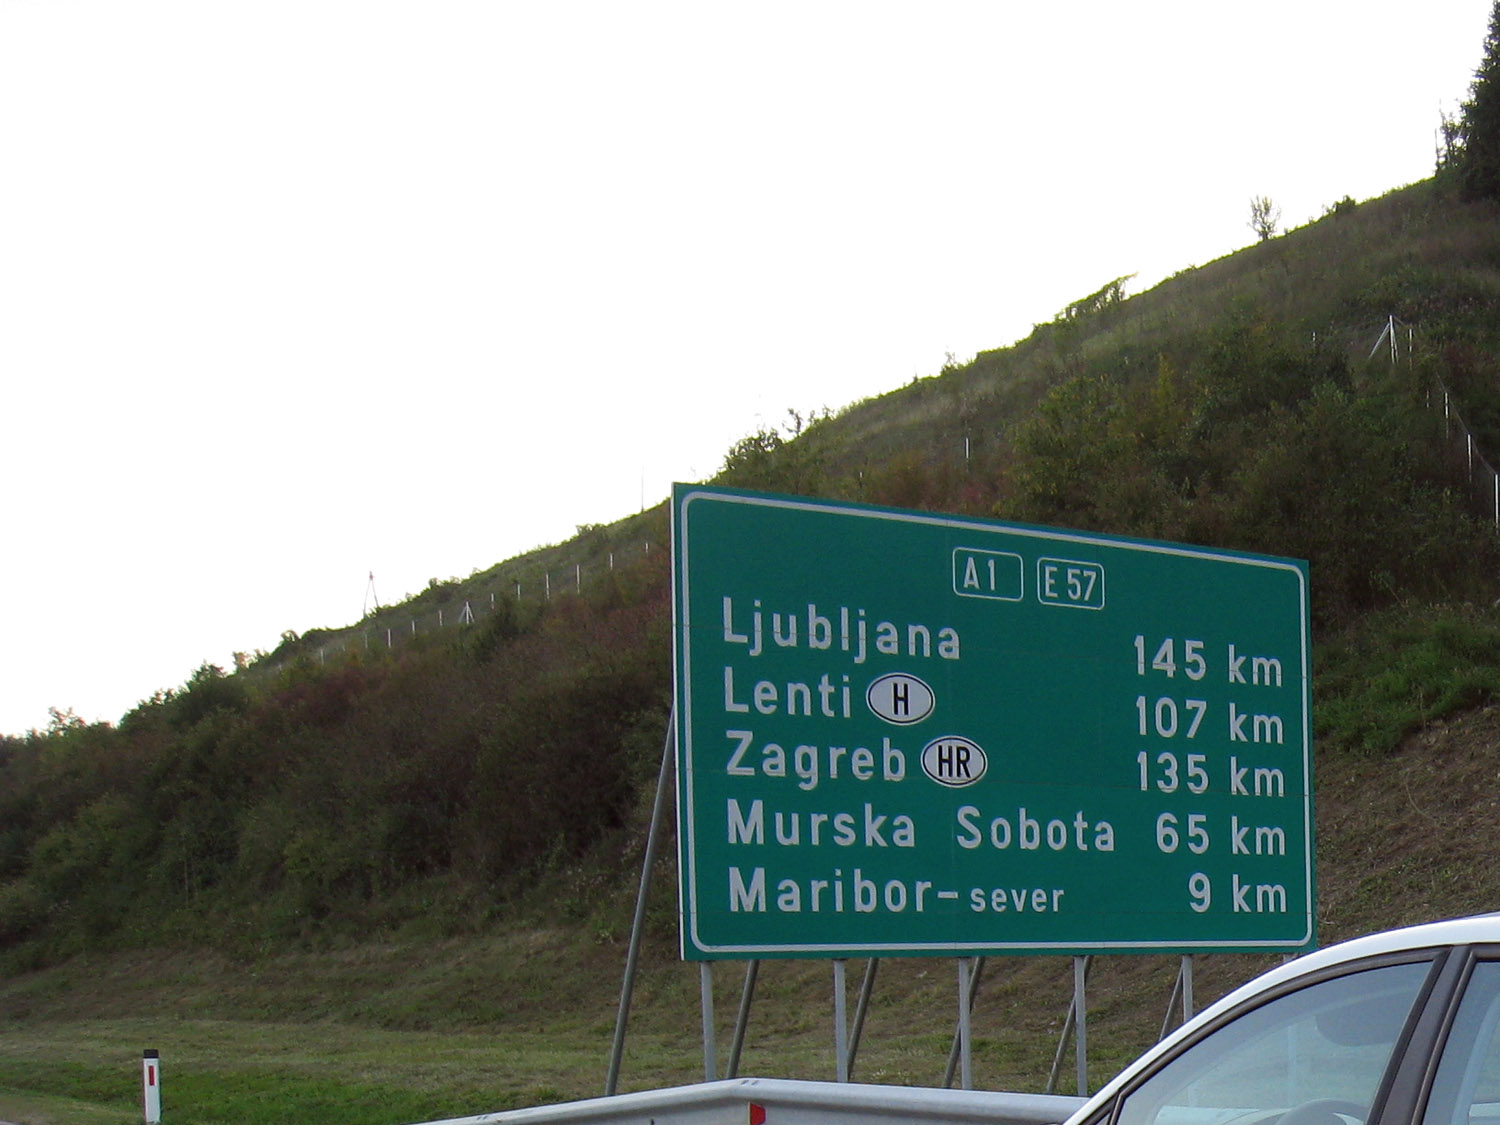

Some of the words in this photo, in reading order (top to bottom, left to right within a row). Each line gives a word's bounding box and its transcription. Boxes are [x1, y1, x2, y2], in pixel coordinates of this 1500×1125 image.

[723, 596, 960, 664] Ljubljana
[1134, 635, 1206, 681] 145
[1229, 644, 1283, 687] km
[723, 666, 852, 718] Lenti
[894, 683, 909, 715] H
[1136, 696, 1207, 738] 107
[1229, 704, 1284, 744] km
[726, 730, 906, 789] Zagreb
[937, 745, 972, 778] HR
[1137, 751, 1208, 794] 135
[1230, 757, 1285, 797] km
[728, 799, 915, 847] Murska
[956, 806, 1115, 851] Sobota
[1155, 813, 1210, 854] 65
[1231, 816, 1286, 856] km
[1189, 873, 1211, 912] 9
[1232, 874, 1287, 913] km
